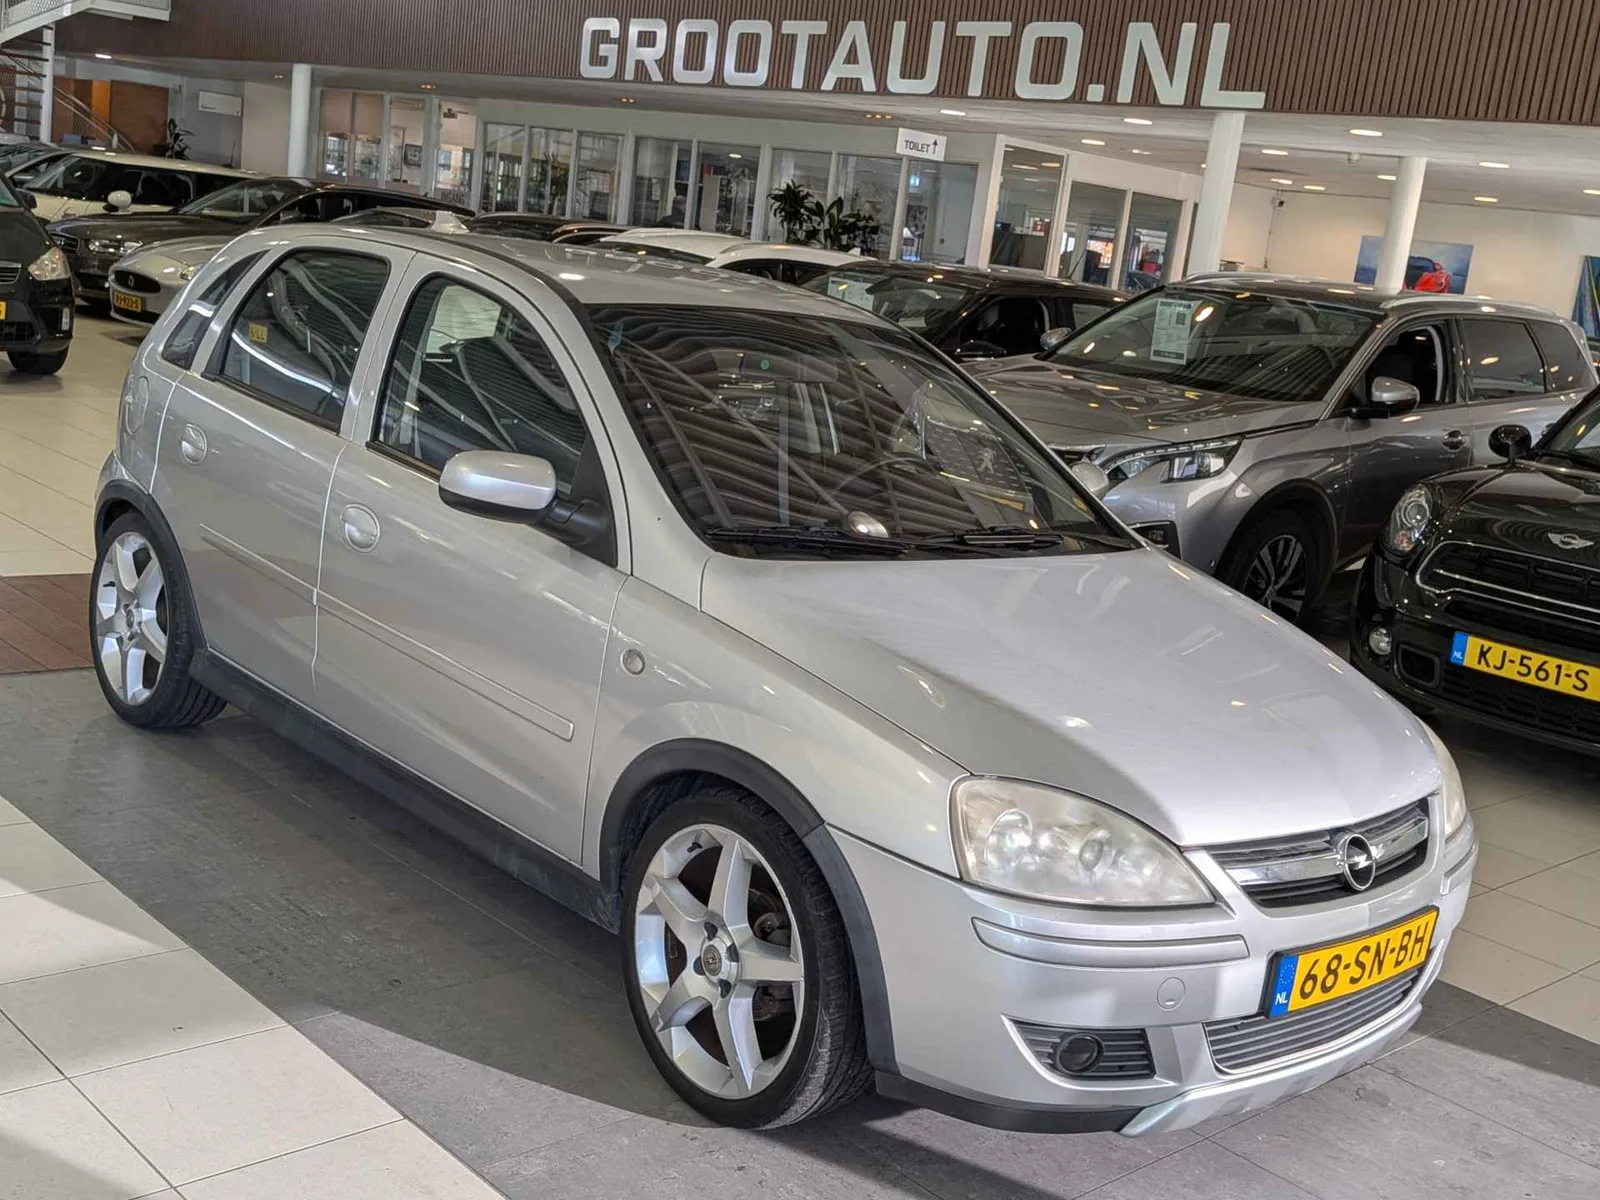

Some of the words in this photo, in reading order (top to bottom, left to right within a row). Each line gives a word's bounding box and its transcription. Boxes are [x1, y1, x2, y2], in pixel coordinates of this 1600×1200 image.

[579, 16, 1266, 109] GROOTAUTO.NL
[904, 139, 930, 154] TOILET
[1477, 643, 1590, 692] KJ-561-S
[1299, 920, 1429, 1000] 68-SN-BH
[1275, 991, 1289, 1005] NL
